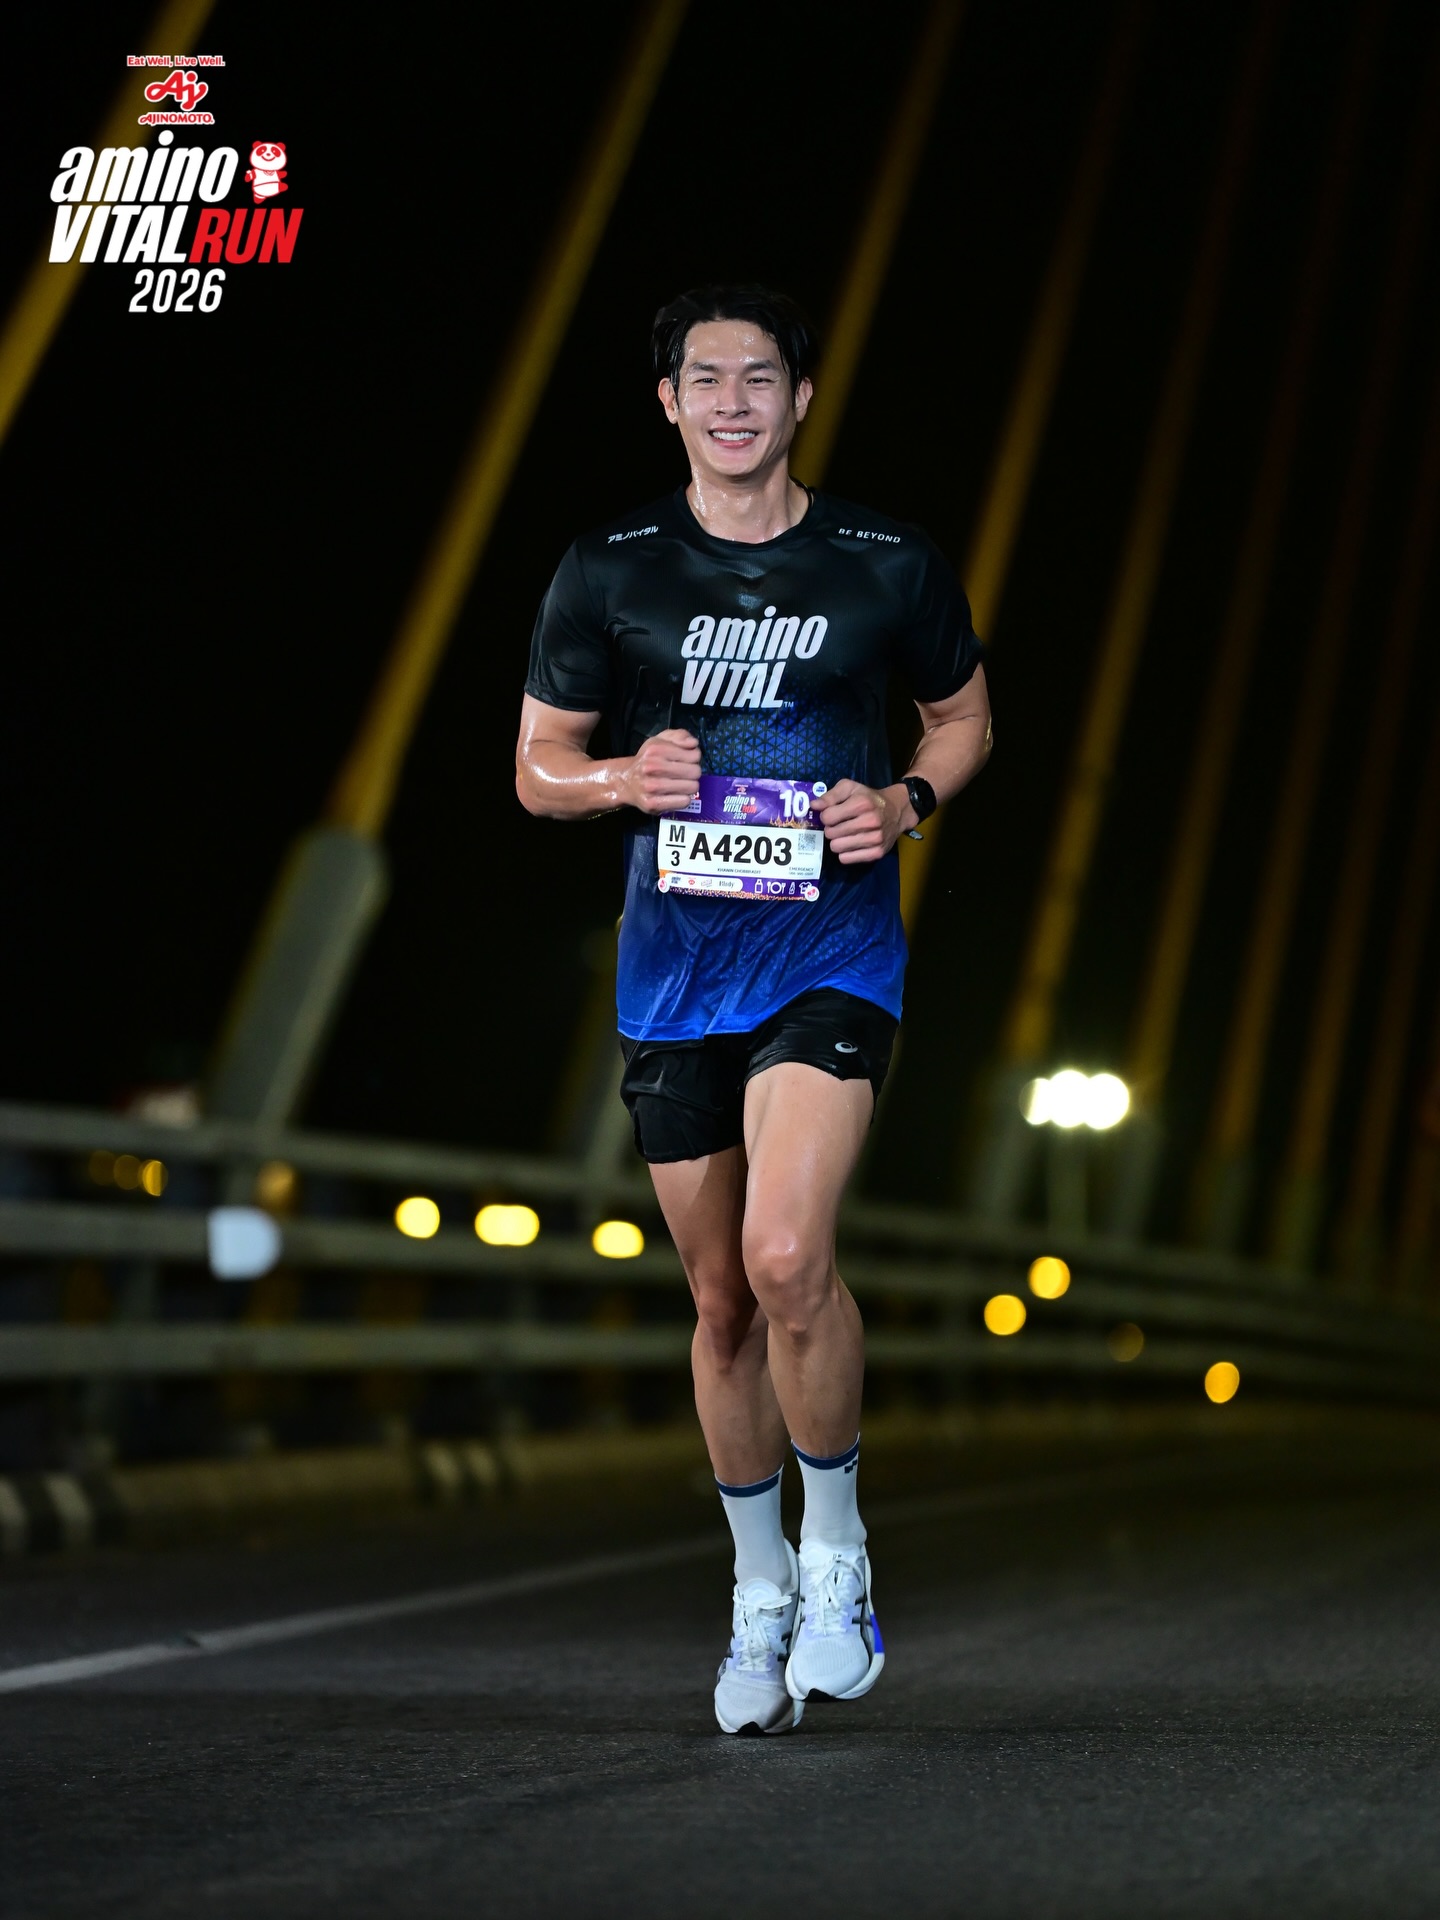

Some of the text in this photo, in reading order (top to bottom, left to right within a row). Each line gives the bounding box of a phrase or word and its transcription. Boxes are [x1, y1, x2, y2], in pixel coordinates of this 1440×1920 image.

[607, 525, 659, 544] アミノバイタル
[838, 527, 901, 544] BE BEYOND
[680, 605, 828, 660] amino
[680, 659, 787, 709] VITAL
[723, 794, 750, 806] amino
[723, 804, 743, 813] VITAL
[779, 789, 810, 818] 10
[669, 824, 685, 843] M
[671, 850, 680, 866] 3
[689, 832, 792, 866] A4203
